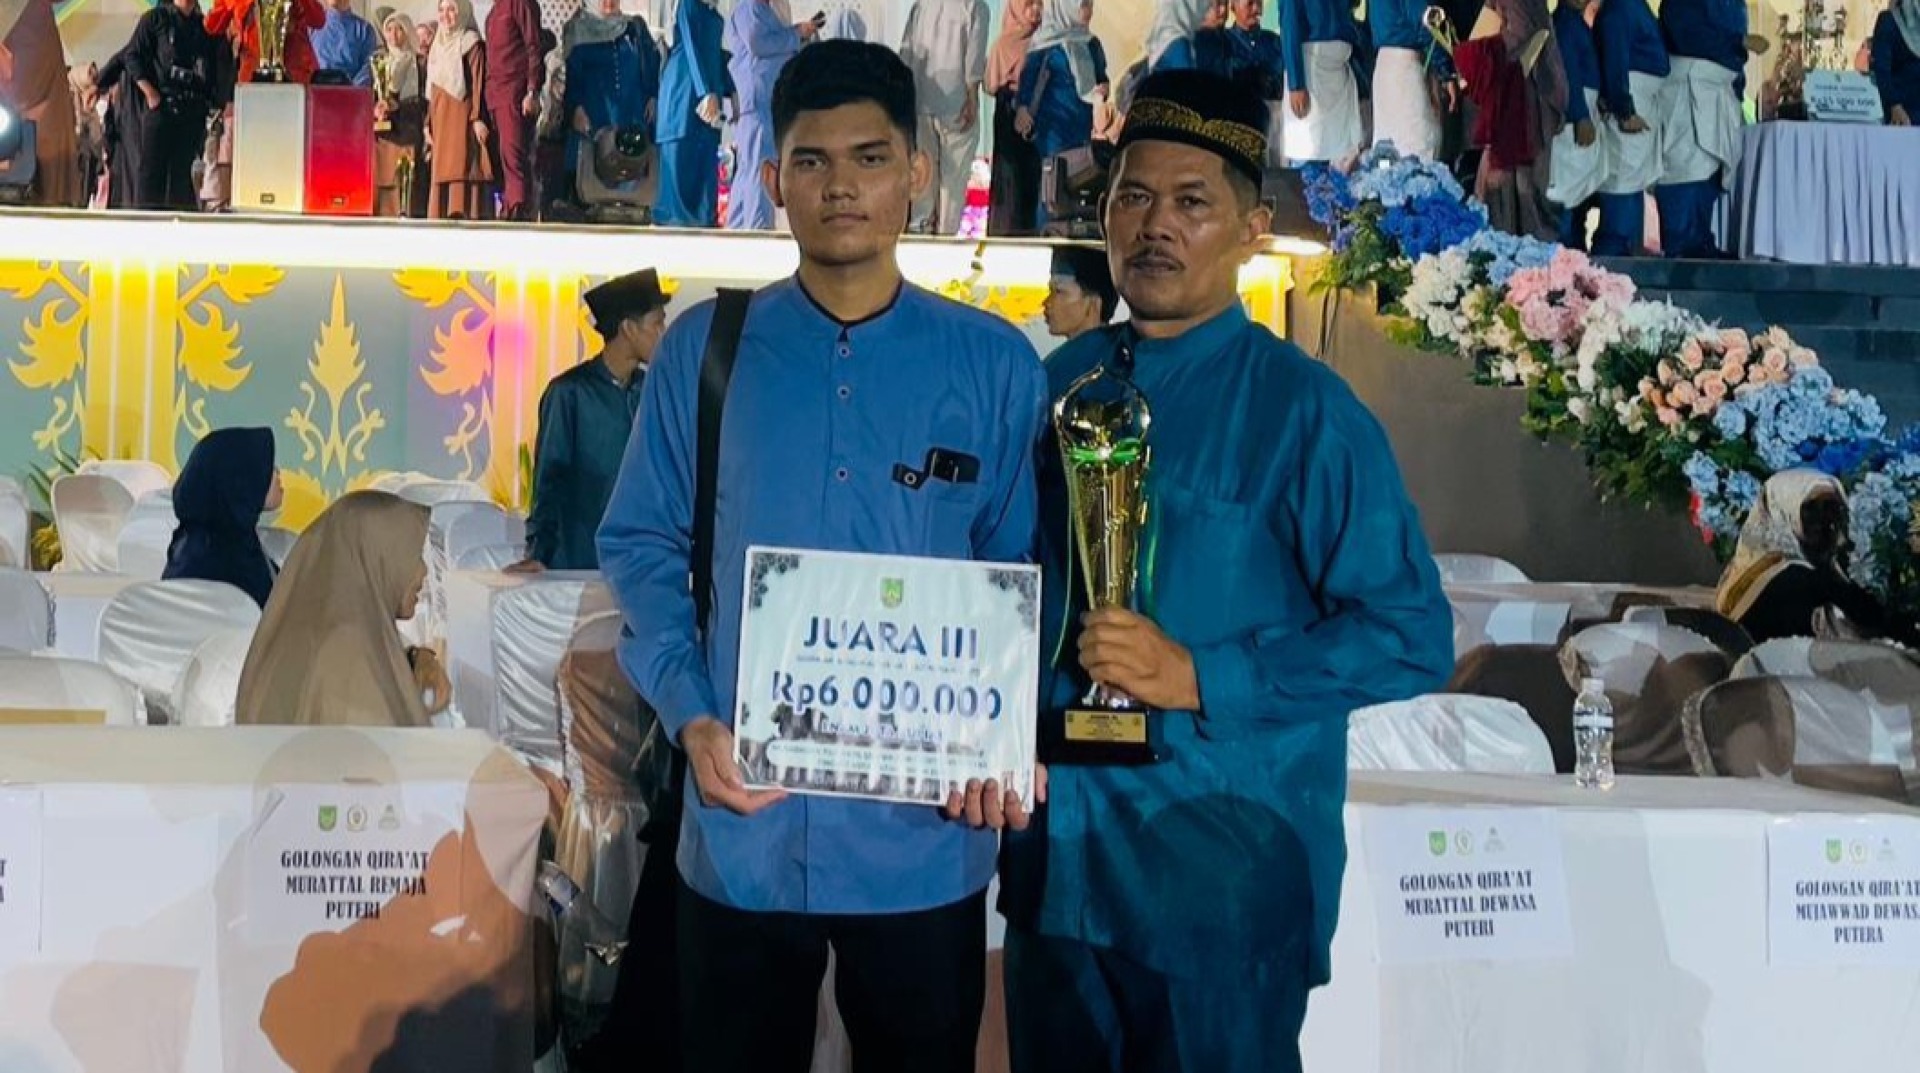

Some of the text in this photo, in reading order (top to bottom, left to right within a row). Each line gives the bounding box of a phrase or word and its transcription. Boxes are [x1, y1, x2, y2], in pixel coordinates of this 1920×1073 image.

[803, 616, 977, 659] JUARA III
[281, 850, 429, 870] GOLONGAN QIRA'AT
[286, 875, 426, 895] MURATTAL REMAJA
[1400, 869, 1532, 891] GOLONGAN QIRA'AT
[1796, 880, 1864, 896] GOLONGAN
[325, 901, 380, 919] PUTERI
[1405, 894, 1536, 915] MURATTAL DEWASA
[1796, 904, 1920, 921] MUJAWWAD DEWAS
[1444, 919, 1494, 938] PUTERI
[1834, 926, 1884, 943] PUTERA
